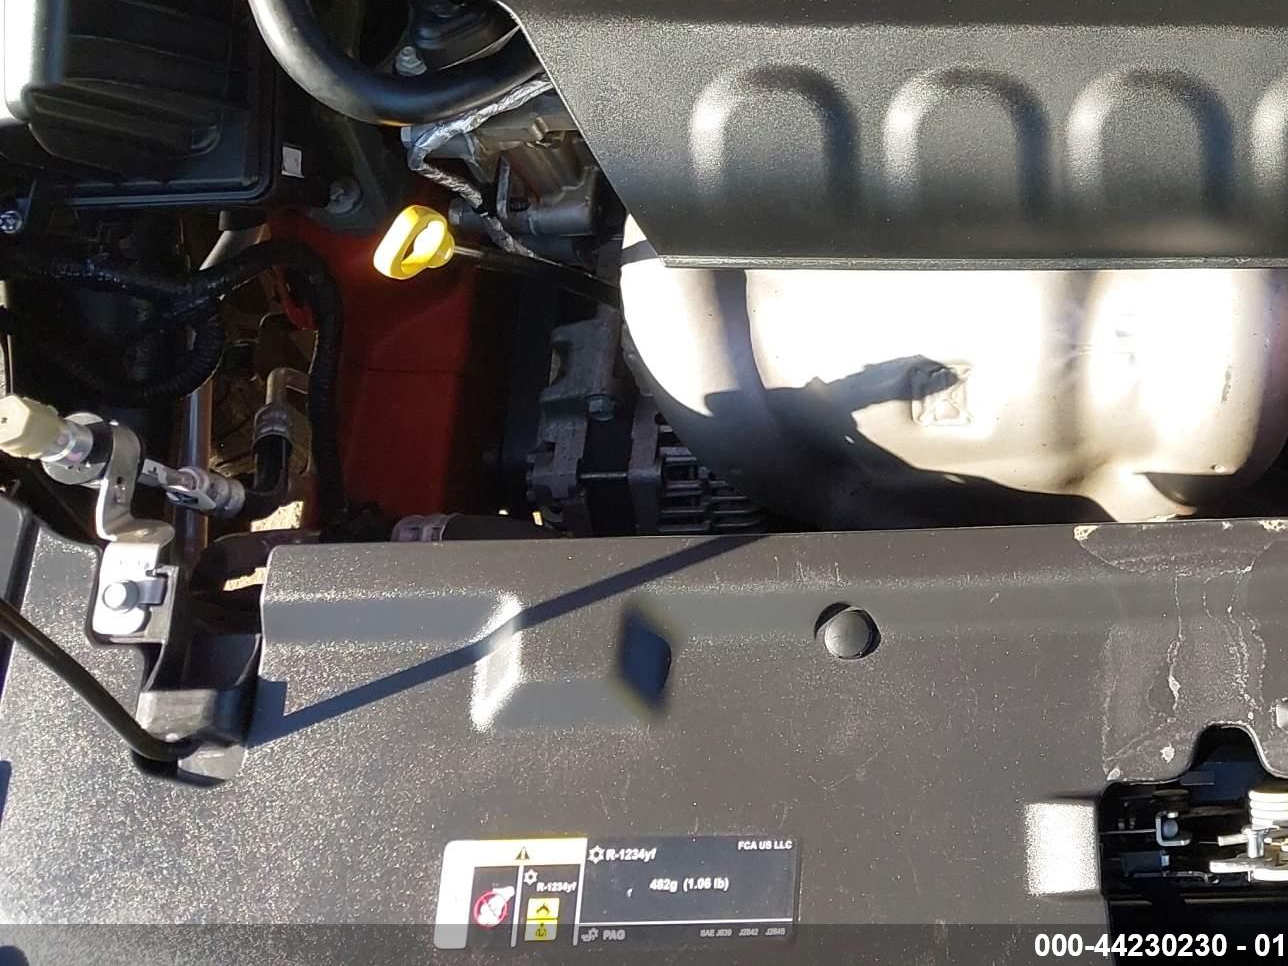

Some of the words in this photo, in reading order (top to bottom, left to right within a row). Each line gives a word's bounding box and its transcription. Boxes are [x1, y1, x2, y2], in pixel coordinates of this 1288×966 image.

[737, 841, 757, 850] FCA
[758, 841, 772, 850] US
[774, 840, 793, 850] LLC
[605, 848, 657, 863] R-1234yf
[536, 881, 577, 893] R-1234yf
[713, 877, 730, 891] lb)
[603, 929, 626, 941] PAG
